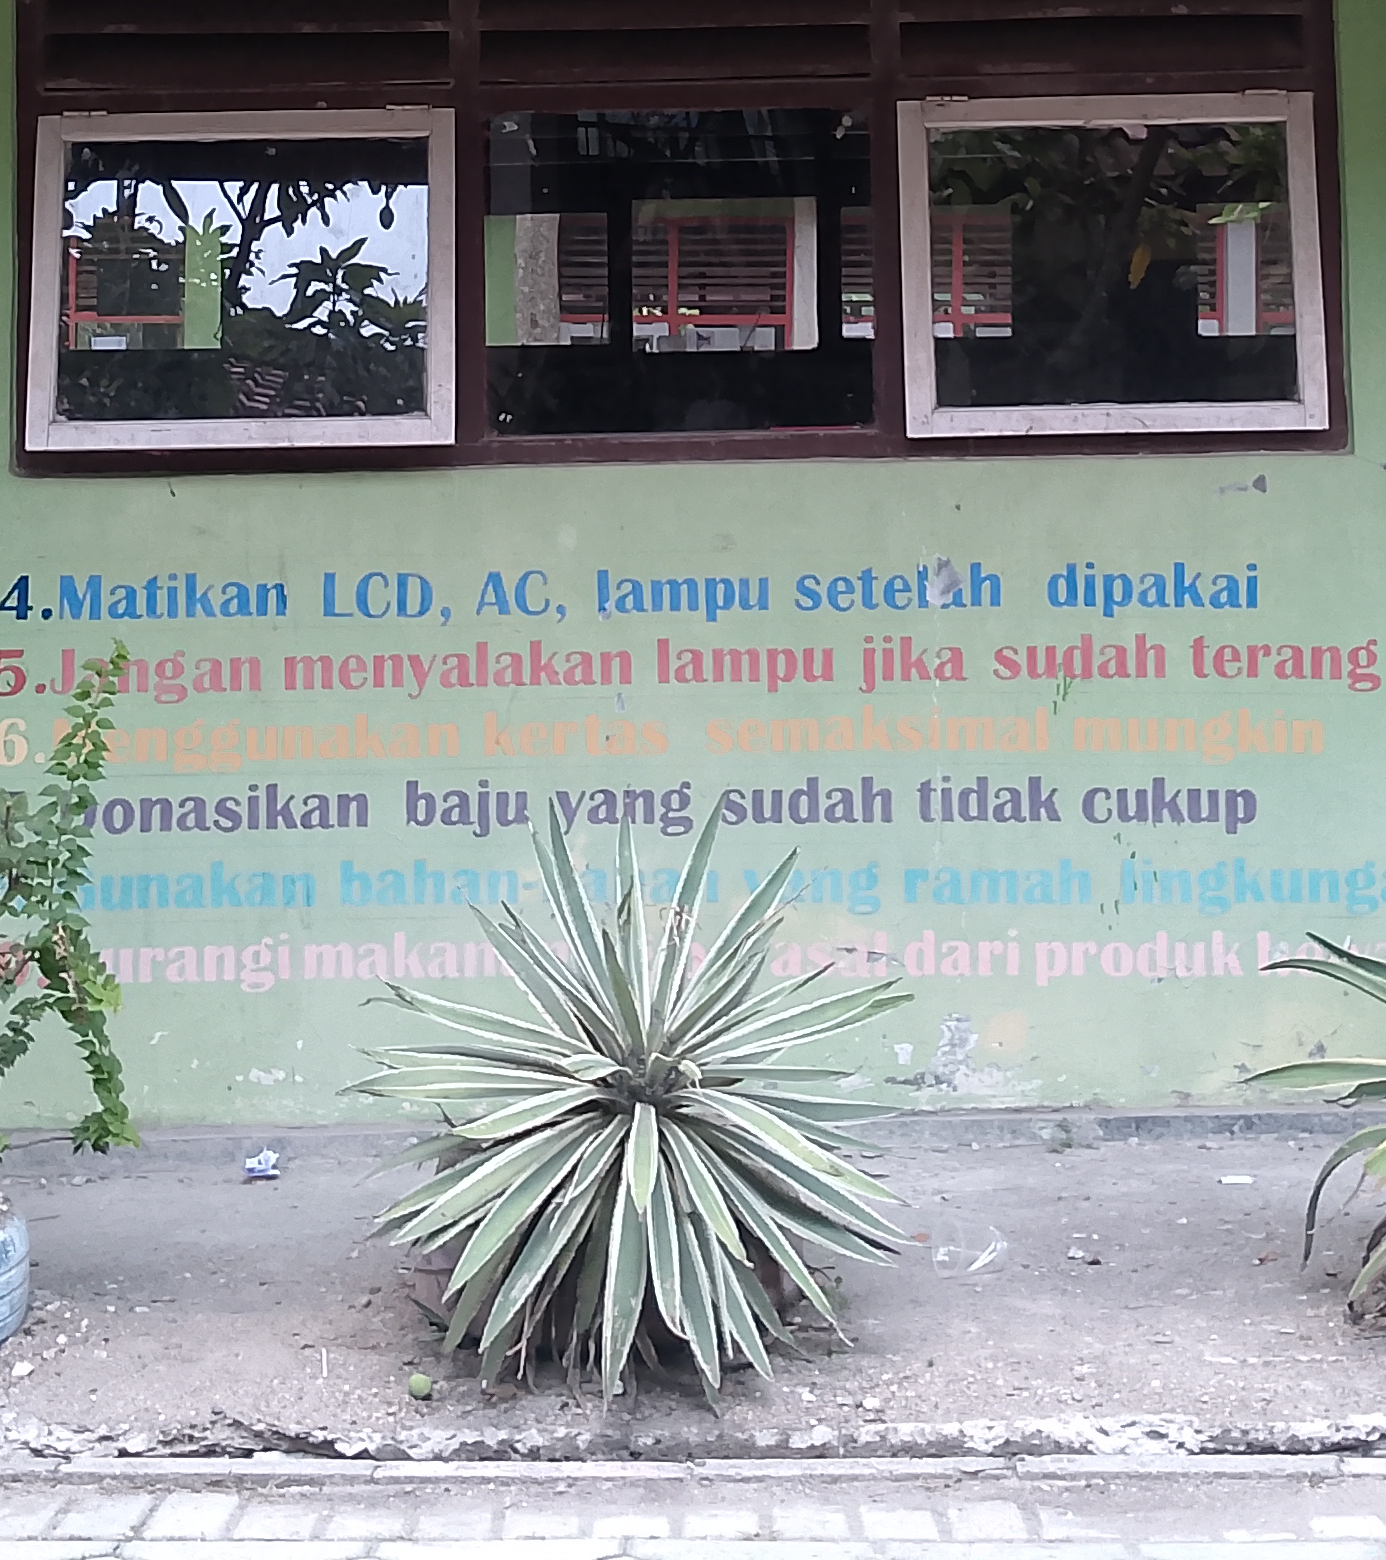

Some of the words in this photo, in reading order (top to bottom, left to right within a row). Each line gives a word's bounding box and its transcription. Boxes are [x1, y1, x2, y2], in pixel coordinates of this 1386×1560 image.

[322, 571, 453, 627] LCD,
[476, 569, 568, 623] AC,
[596, 569, 771, 622] lampu
[1047, 562, 1260, 618] dipakai
[284, 640, 633, 700] menyalakan
[656, 638, 834, 694] lampu
[859, 635, 969, 694] jika
[993, 633, 1167, 681] sudah
[1190, 636, 1382, 693] terang
[483, 711, 671, 757] kertas
[705, 705, 1050, 756] semaksimal
[1073, 707, 1325, 766] mungkin
[405, 779, 530, 838] baju
[555, 781, 696, 837] yang
[720, 776, 893, 826] sudah
[916, 776, 1063, 824] tidak
[1081, 776, 1259, 835] cukup
[904, 859, 1092, 905] ramah
[904, 929, 1021, 978] dari
[1035, 930, 1245, 987] produk
